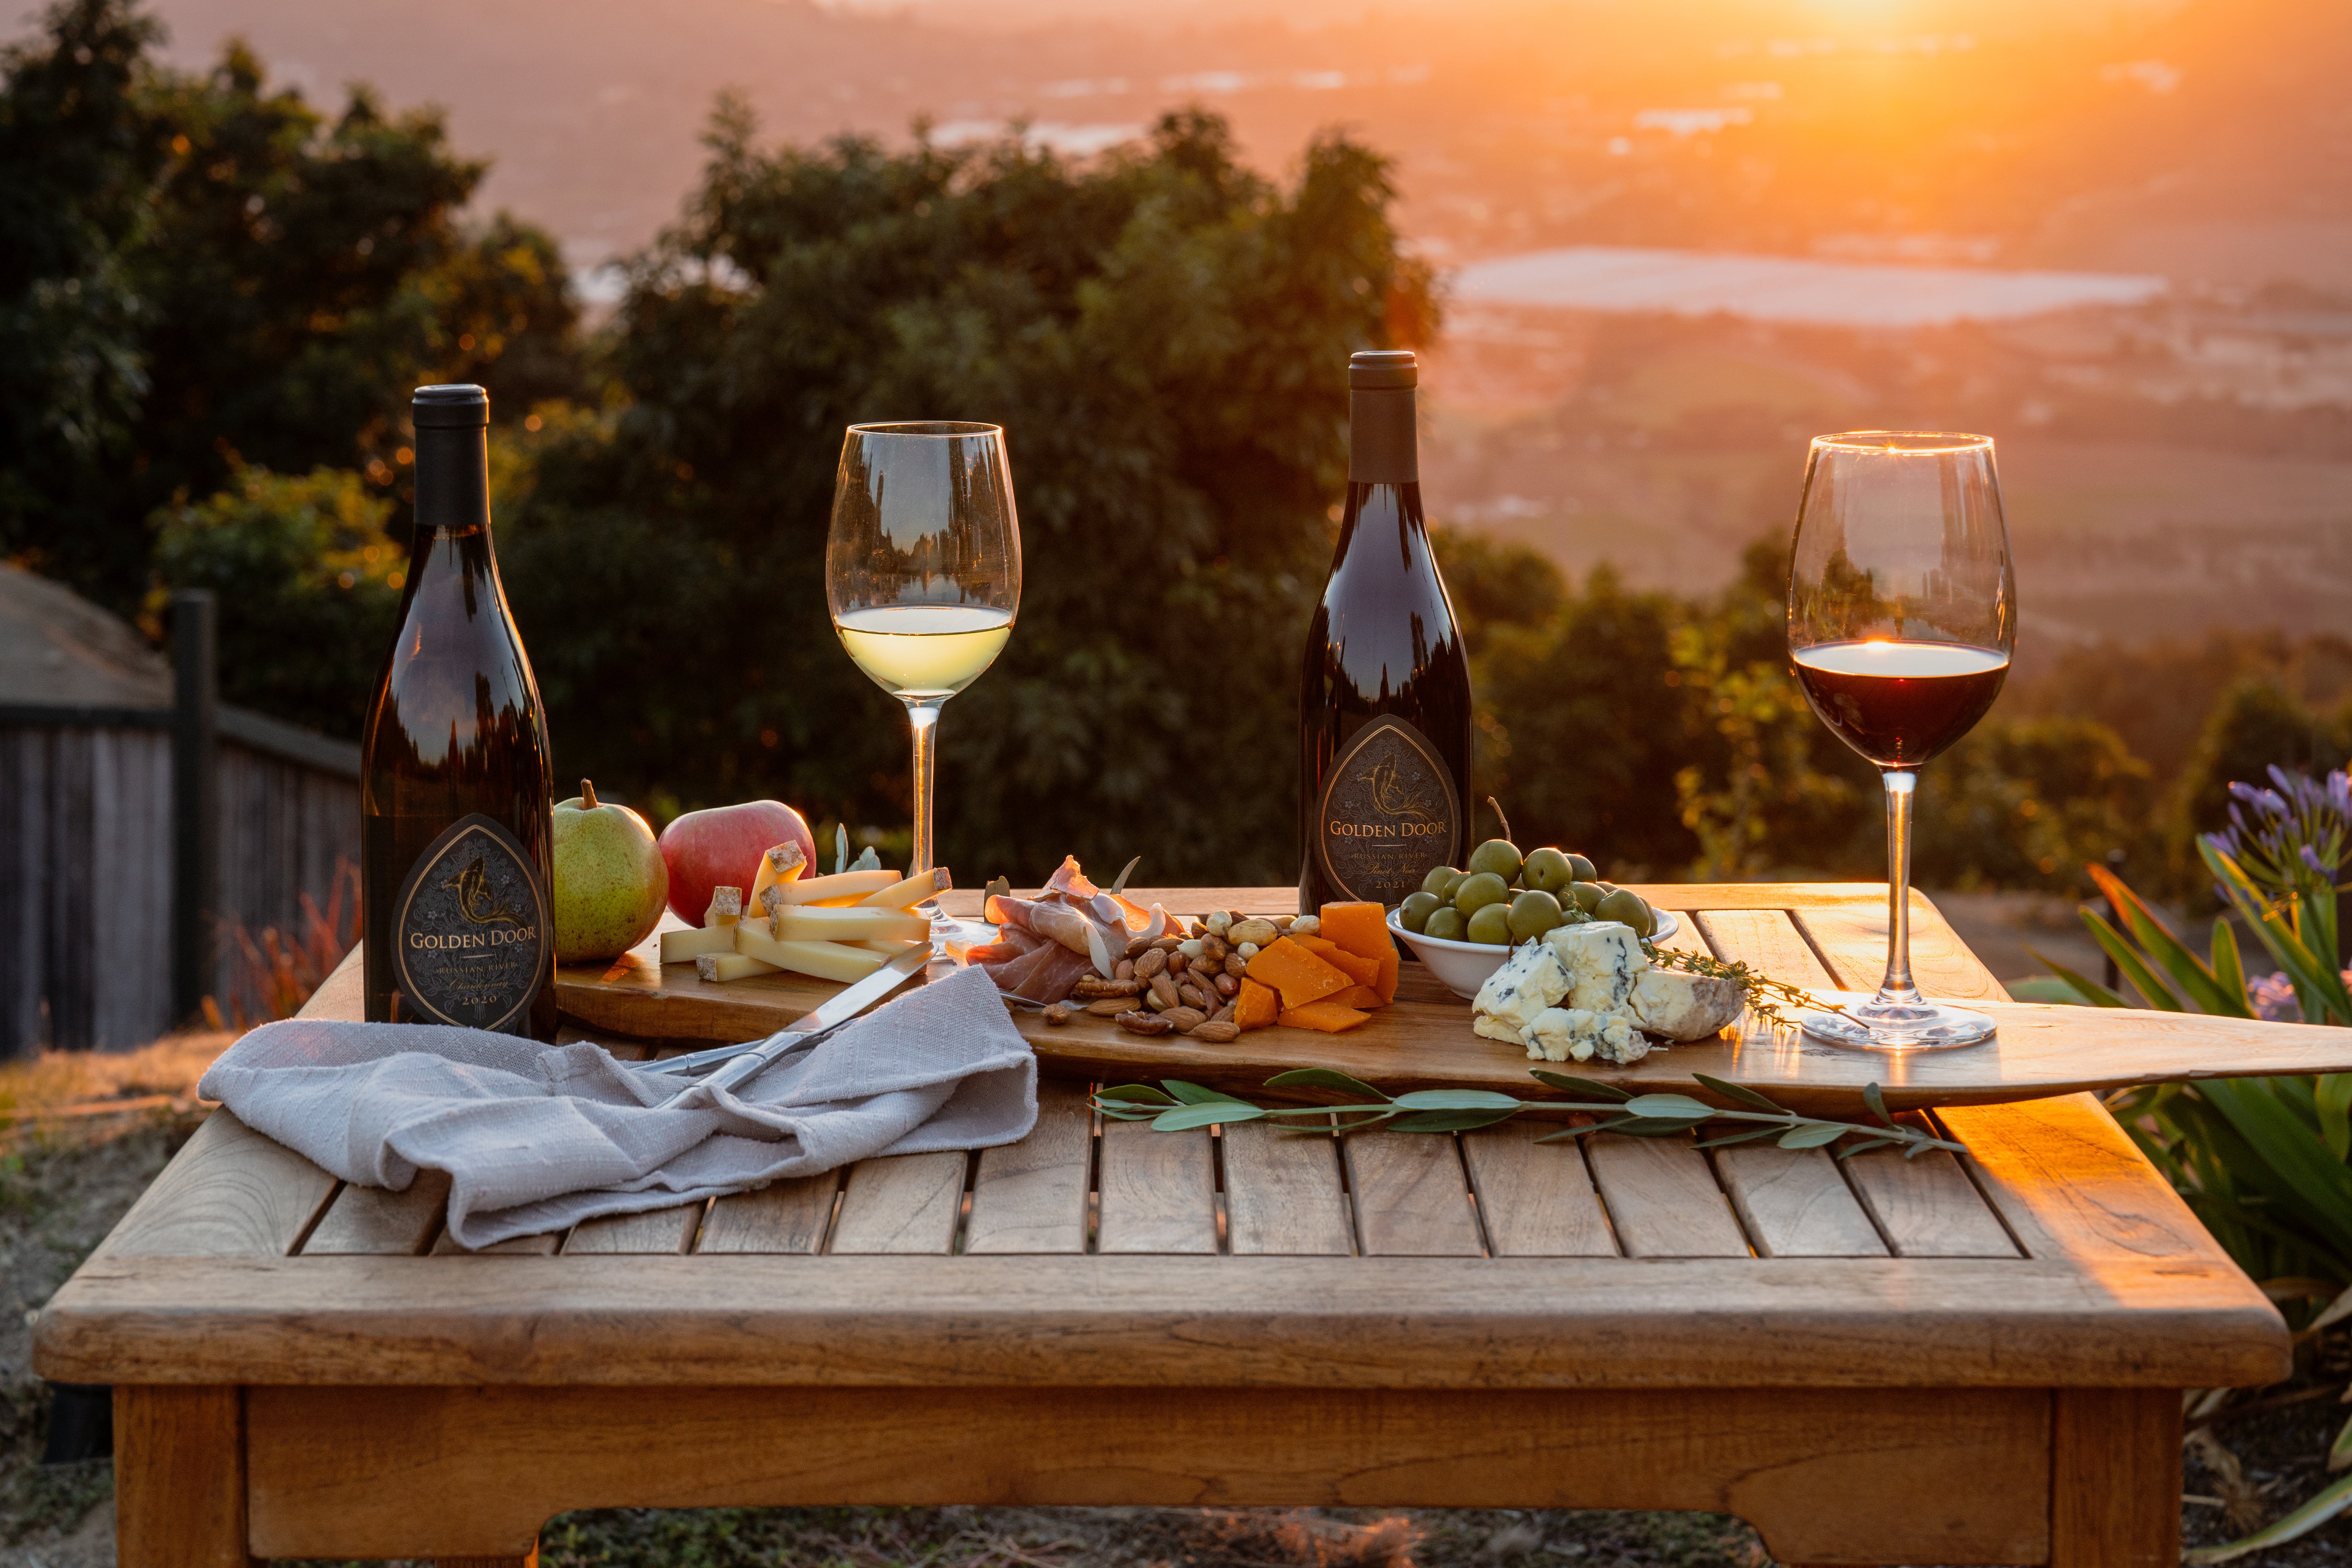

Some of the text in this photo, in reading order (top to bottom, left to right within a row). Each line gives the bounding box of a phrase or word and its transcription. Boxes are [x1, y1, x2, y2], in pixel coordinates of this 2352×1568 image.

[1330, 821, 1446, 837] GOLDEN DOOR
[1364, 861, 1416, 874] Pinot Noir
[410, 926, 536, 949] GOLDEN DOOR
[439, 962, 516, 974] RUSSIAN RIVER
[449, 978, 508, 991] Chardonnay
[462, 995, 497, 1005] 2020
